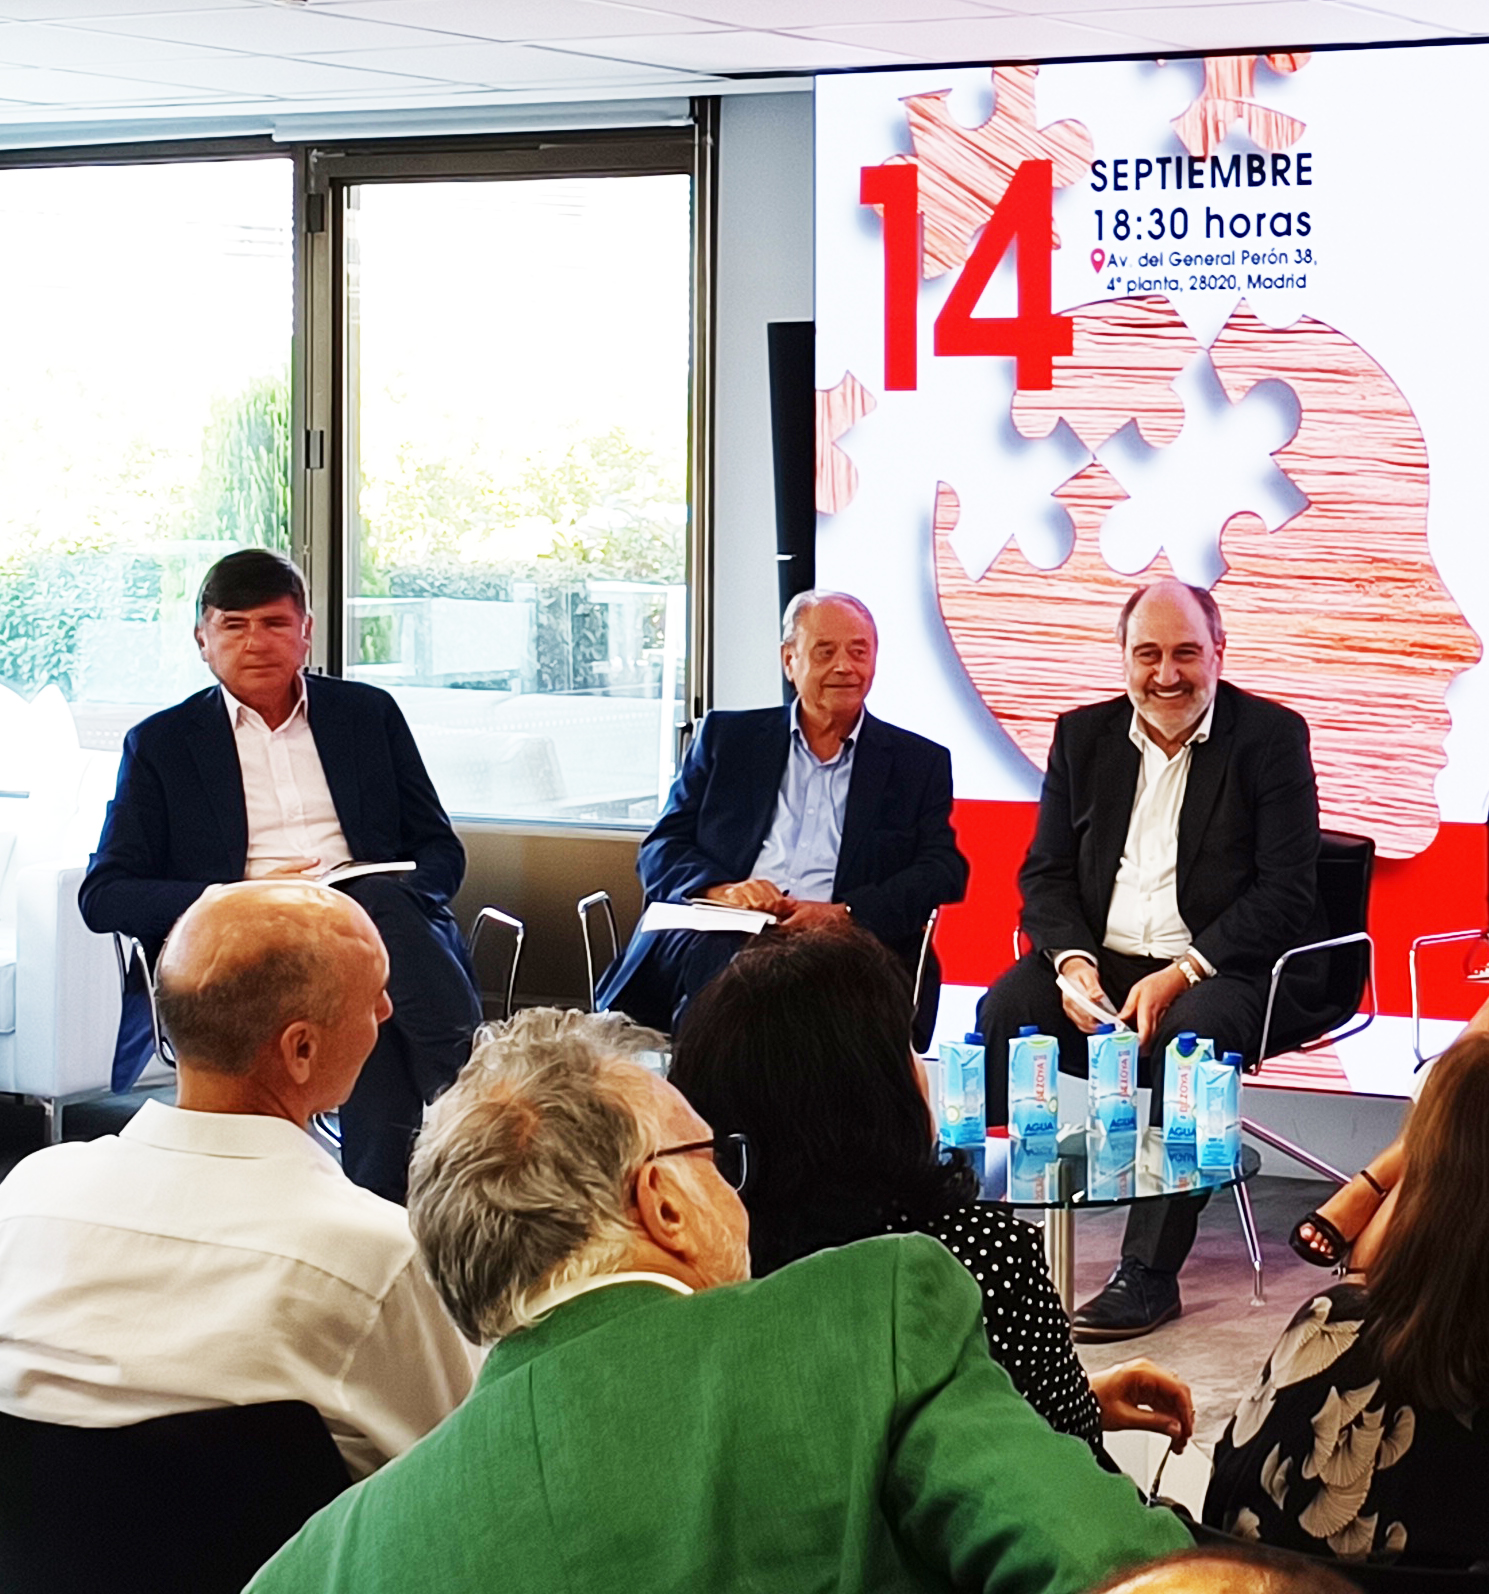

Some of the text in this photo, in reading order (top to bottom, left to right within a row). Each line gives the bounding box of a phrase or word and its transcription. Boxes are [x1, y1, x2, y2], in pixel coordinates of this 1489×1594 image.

[1090, 153, 1313, 192] SEPTIEMBRE
[1094, 206, 1311, 241] 18:30 horas
[1138, 252, 1164, 267] del
[1169, 251, 1235, 267] General
[1241, 248, 1288, 265] Perón
[1294, 249, 1317, 266] 38,
[860, 159, 1073, 391] 14
[1127, 275, 1183, 296] planta,
[1189, 274, 1241, 291] 28020,
[1247, 274, 1307, 289] Madrid
[1025, 1121, 1054, 1132] AGUA
